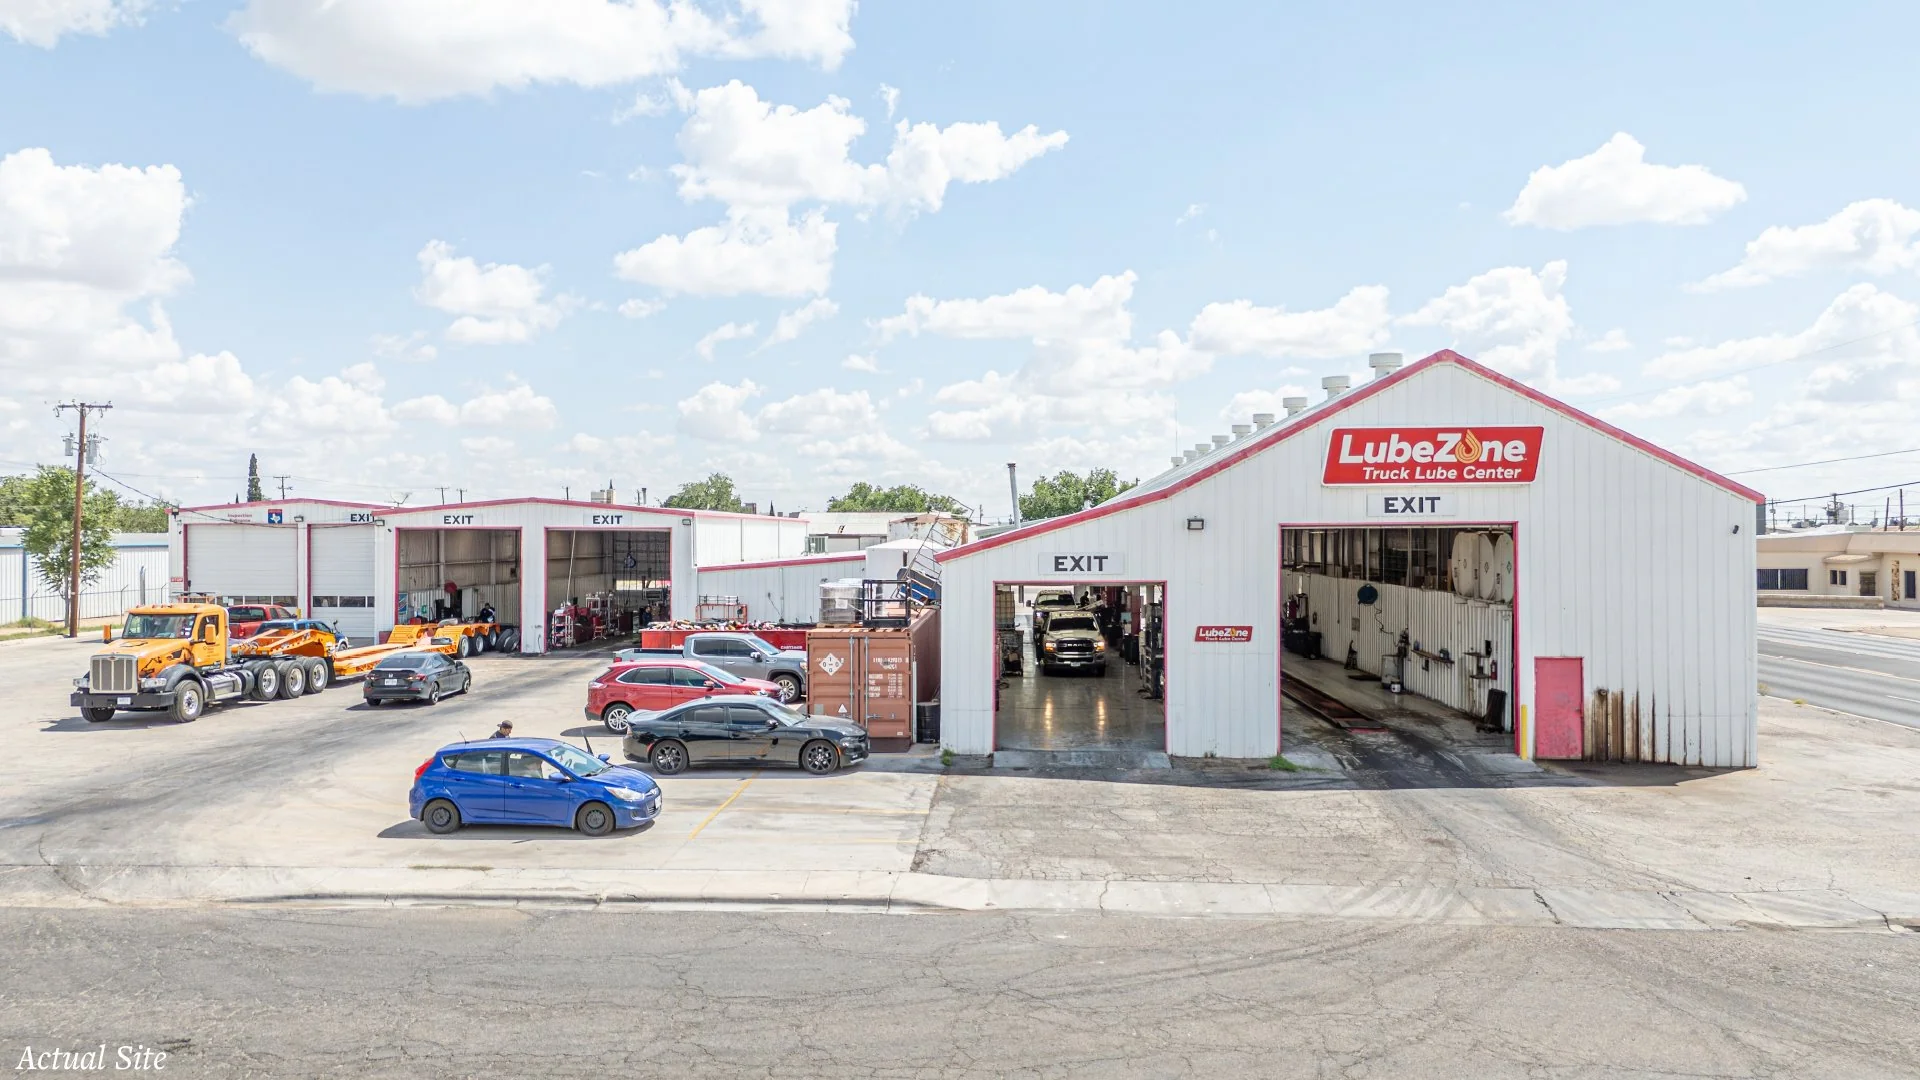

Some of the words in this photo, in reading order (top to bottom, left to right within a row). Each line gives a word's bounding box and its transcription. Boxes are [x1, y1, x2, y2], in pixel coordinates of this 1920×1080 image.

[1339, 429, 1526, 464] LubeZone
[1363, 466, 1410, 480] Truck
[1414, 466, 1458, 480] Lube
[1463, 465, 1522, 480] Center
[1384, 496, 1441, 513] EXIT
[443, 515, 474, 524] EXIT
[592, 515, 623, 524] EXIT
[1054, 555, 1109, 571] EXIT
[1199, 627, 1249, 637] LubeZone
